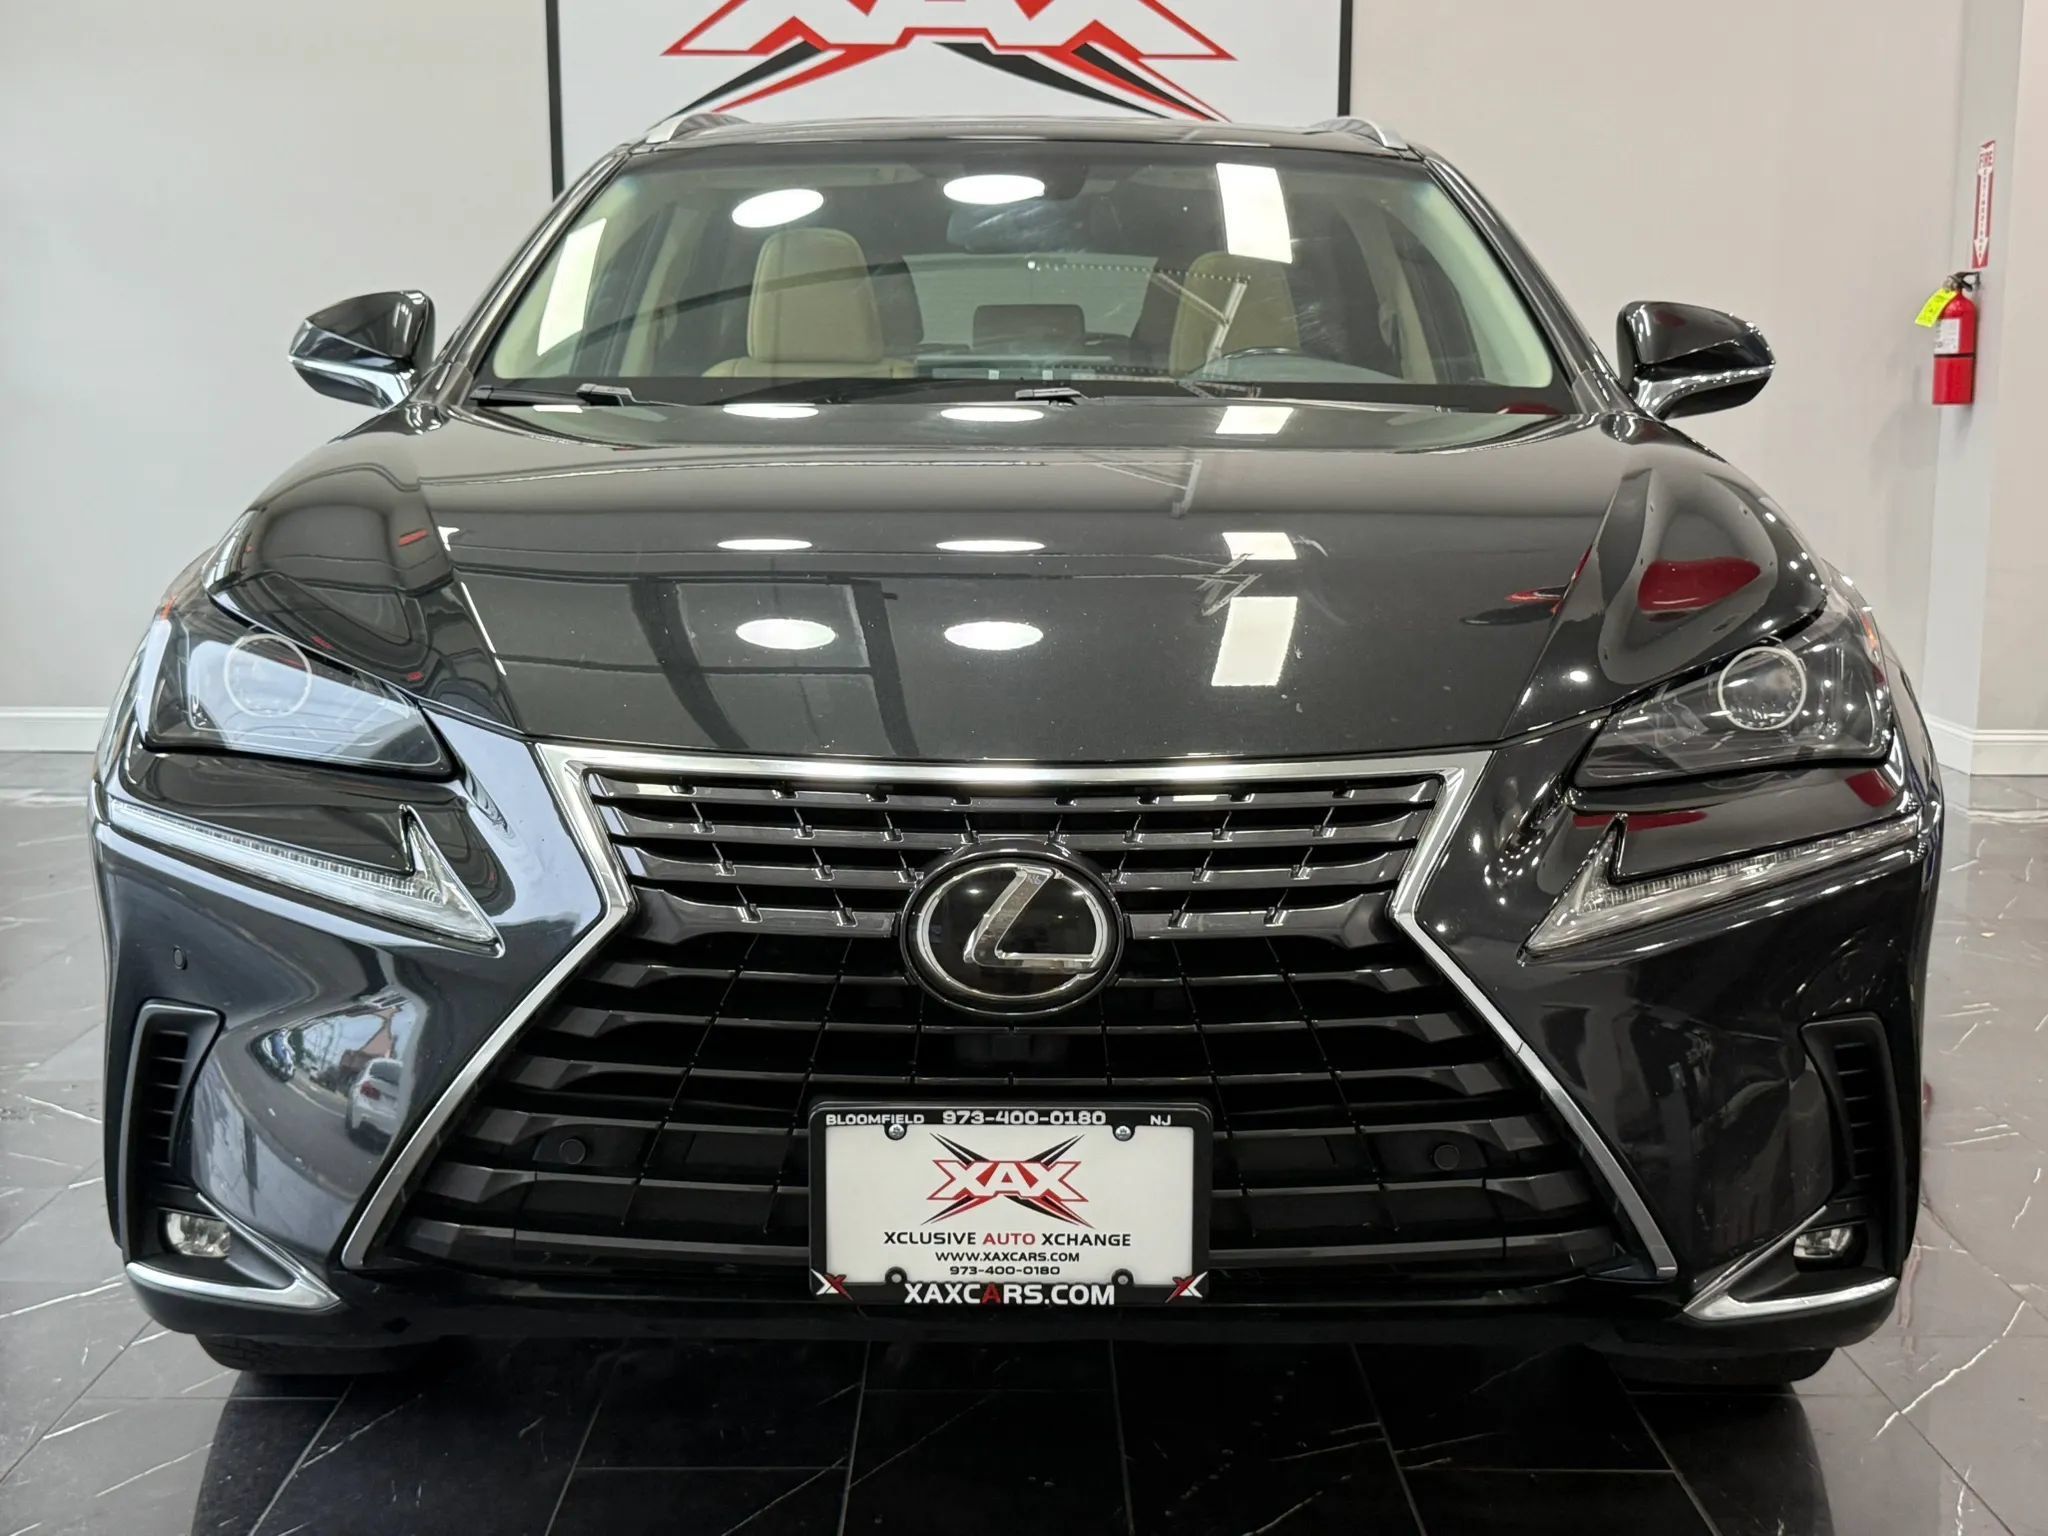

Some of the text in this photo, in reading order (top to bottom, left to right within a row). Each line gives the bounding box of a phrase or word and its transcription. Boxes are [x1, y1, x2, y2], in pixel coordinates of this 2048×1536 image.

[826, 1110, 1172, 1126] BLOOMFIELD 973-400-0180 NJ
[927, 1160, 1089, 1202] XAX
[883, 1231, 1131, 1246] XCLUSIVE AUTO XCHANGE
[936, 1251, 1080, 1262] WWW.XAXCARS.COM
[949, 1267, 1060, 1275] 973-400-0180
[905, 1283, 1114, 1305] XAXCARS.COM
